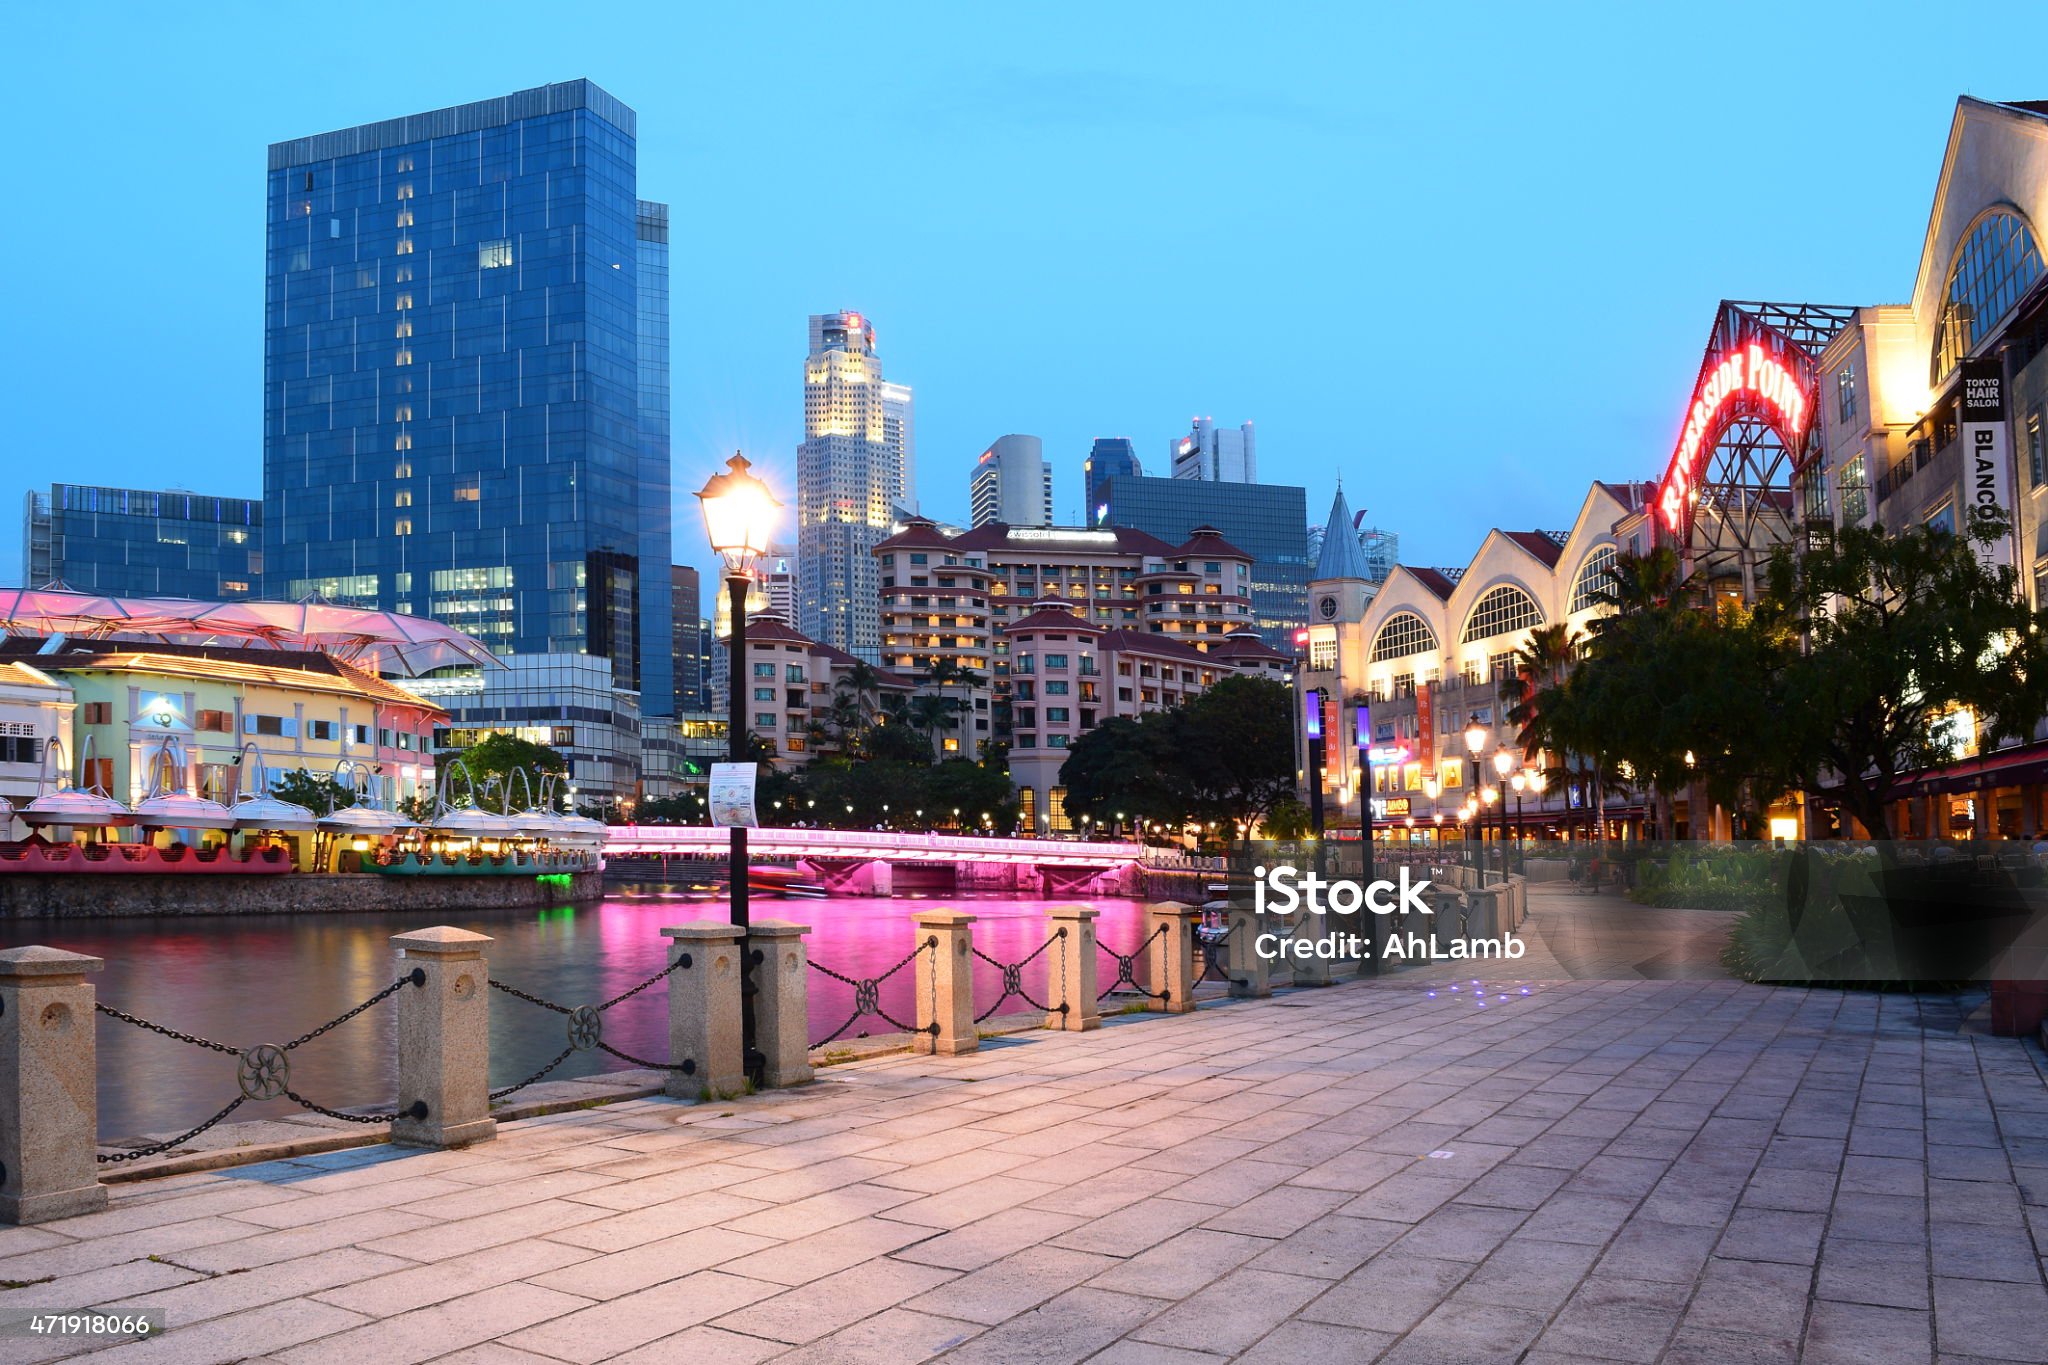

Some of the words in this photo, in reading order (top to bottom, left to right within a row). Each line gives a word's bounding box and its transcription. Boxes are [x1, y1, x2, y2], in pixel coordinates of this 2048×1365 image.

[1966, 378, 1999, 387] TOKYO
[1966, 387, 1999, 399] HAIR
[1967, 399, 1999, 408] SALON
[1661, 352, 1744, 530] RIVERSIDE
[1747, 344, 1805, 433] POINT
[1975, 430, 1996, 521] BLANCO
